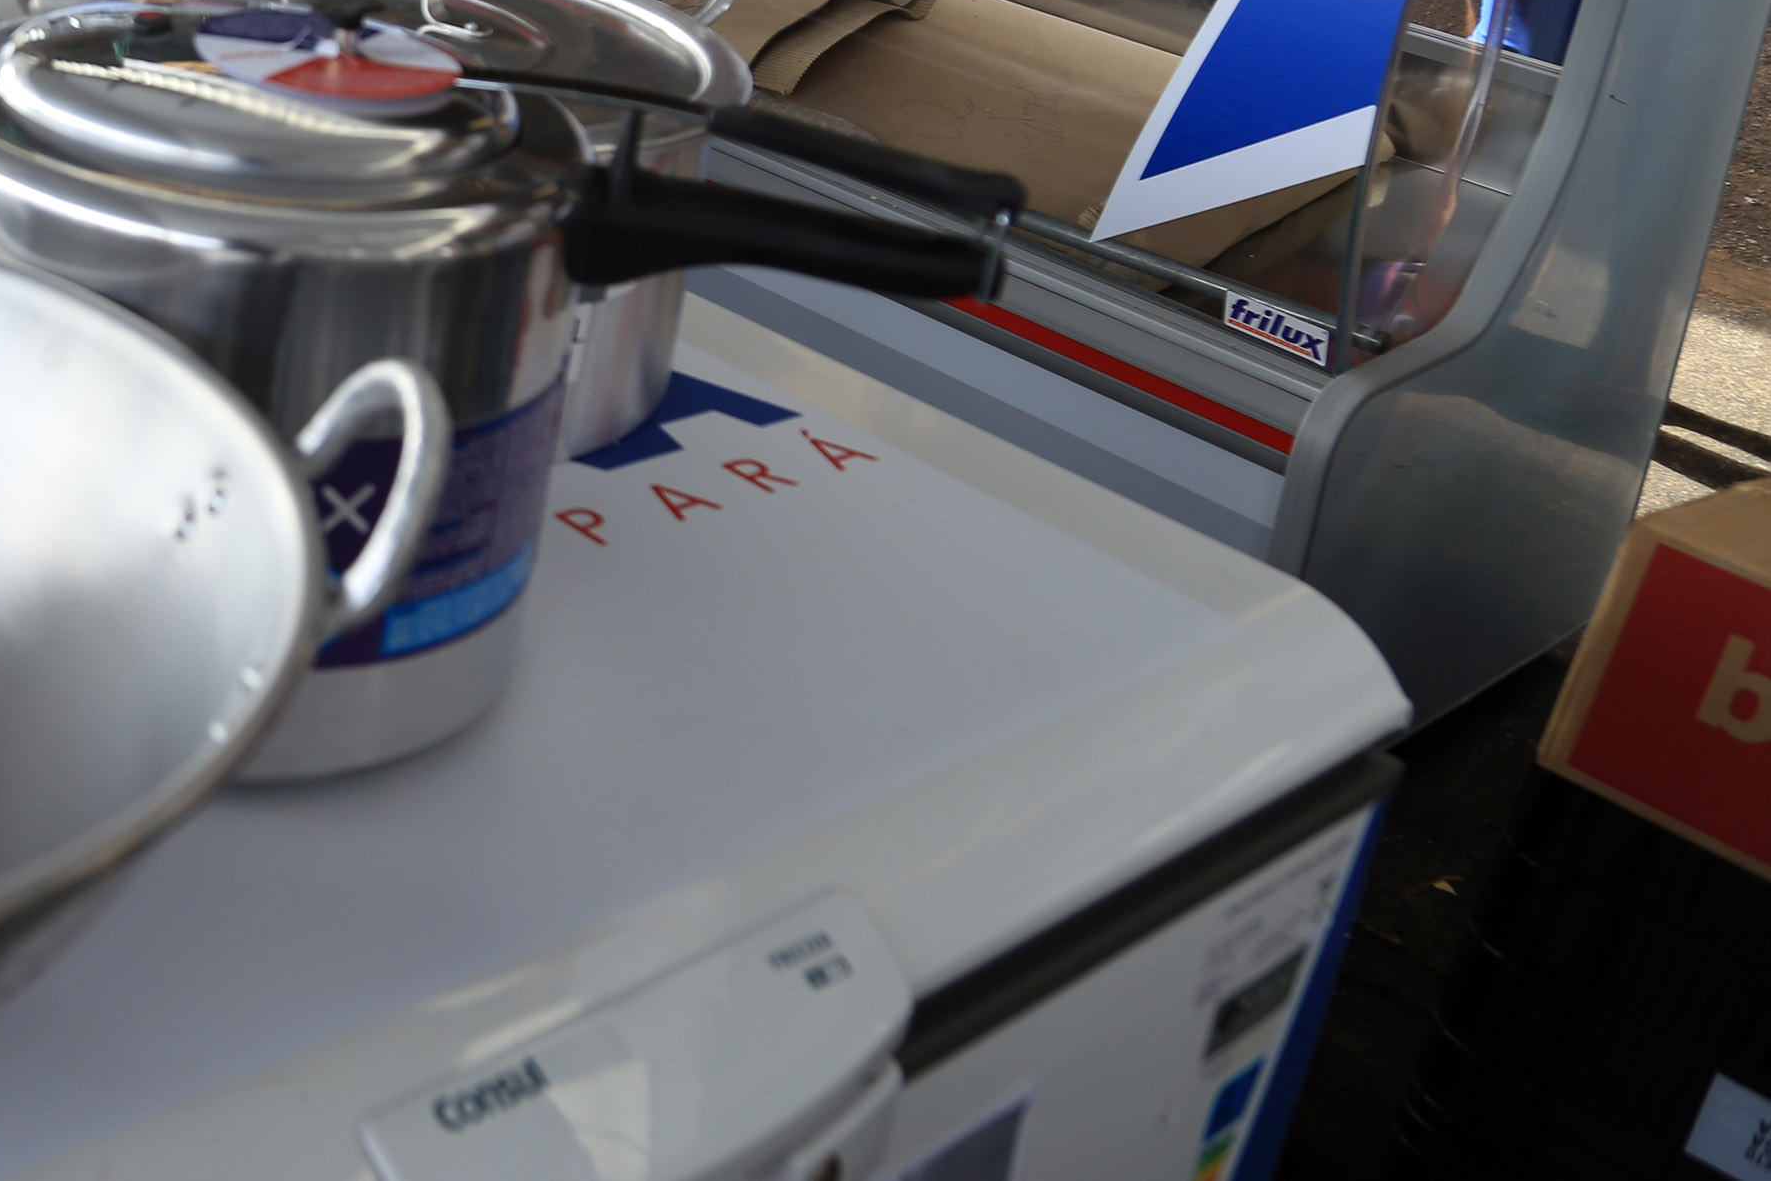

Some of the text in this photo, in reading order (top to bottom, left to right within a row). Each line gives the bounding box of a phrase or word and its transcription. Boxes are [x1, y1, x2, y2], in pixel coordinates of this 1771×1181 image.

[1230, 298, 1325, 362] frilux
[556, 428, 879, 547] PARÁ
[434, 1055, 549, 1133] Consul
